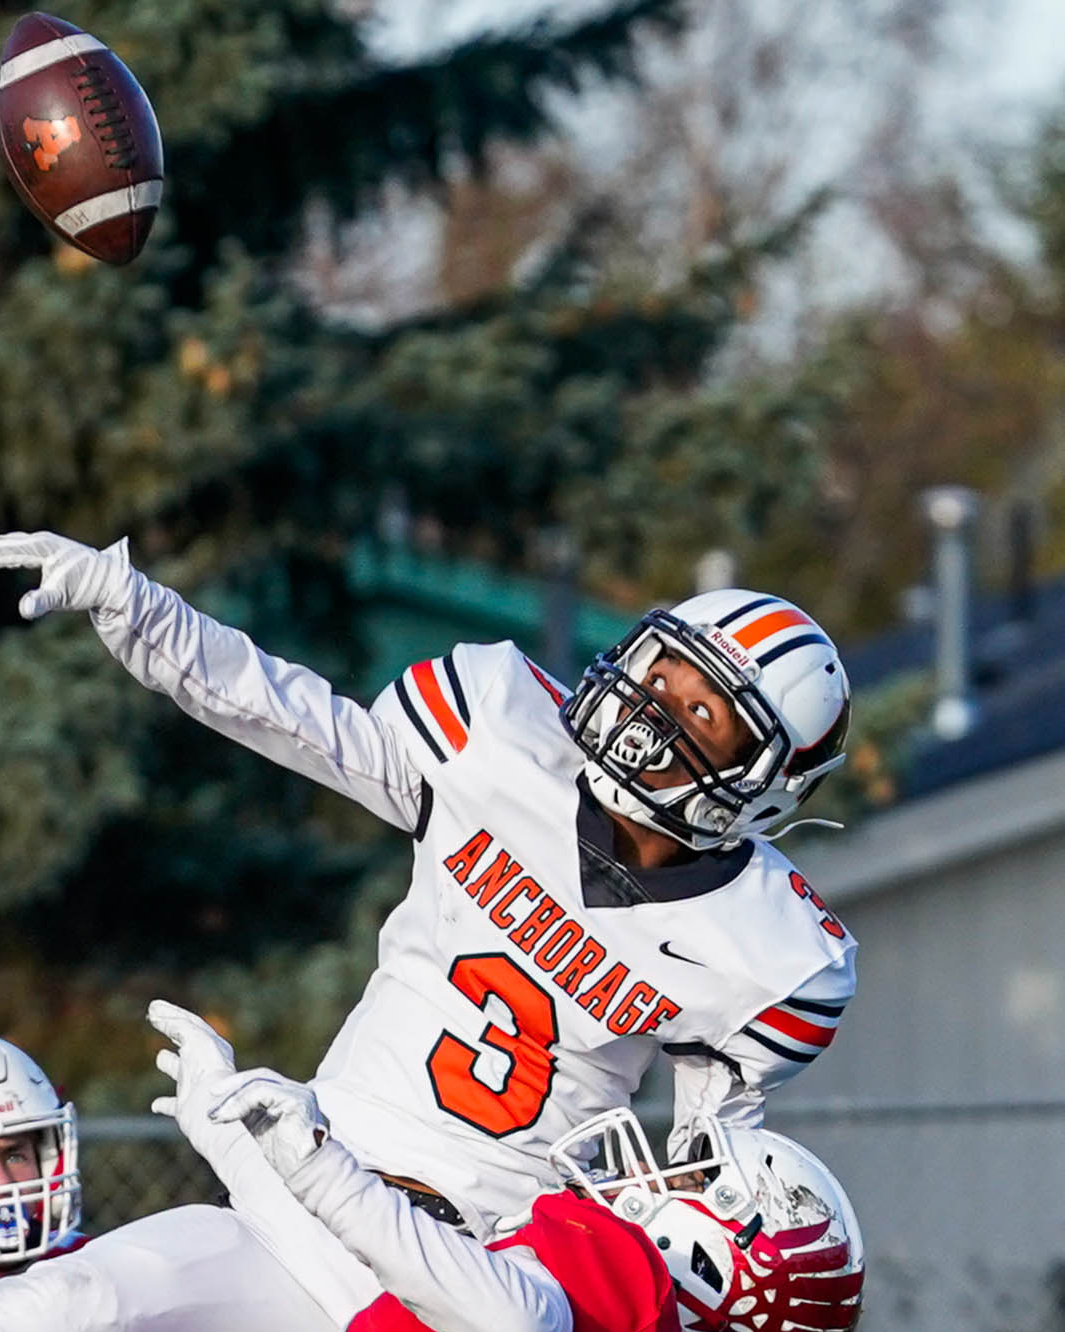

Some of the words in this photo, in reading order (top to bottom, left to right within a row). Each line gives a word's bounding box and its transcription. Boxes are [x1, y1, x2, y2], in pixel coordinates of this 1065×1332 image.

[710, 630, 751, 667] Riddell
[442, 828, 684, 1036] ANCHORAGE
[787, 869, 846, 940] 3
[426, 951, 560, 1139] 3
